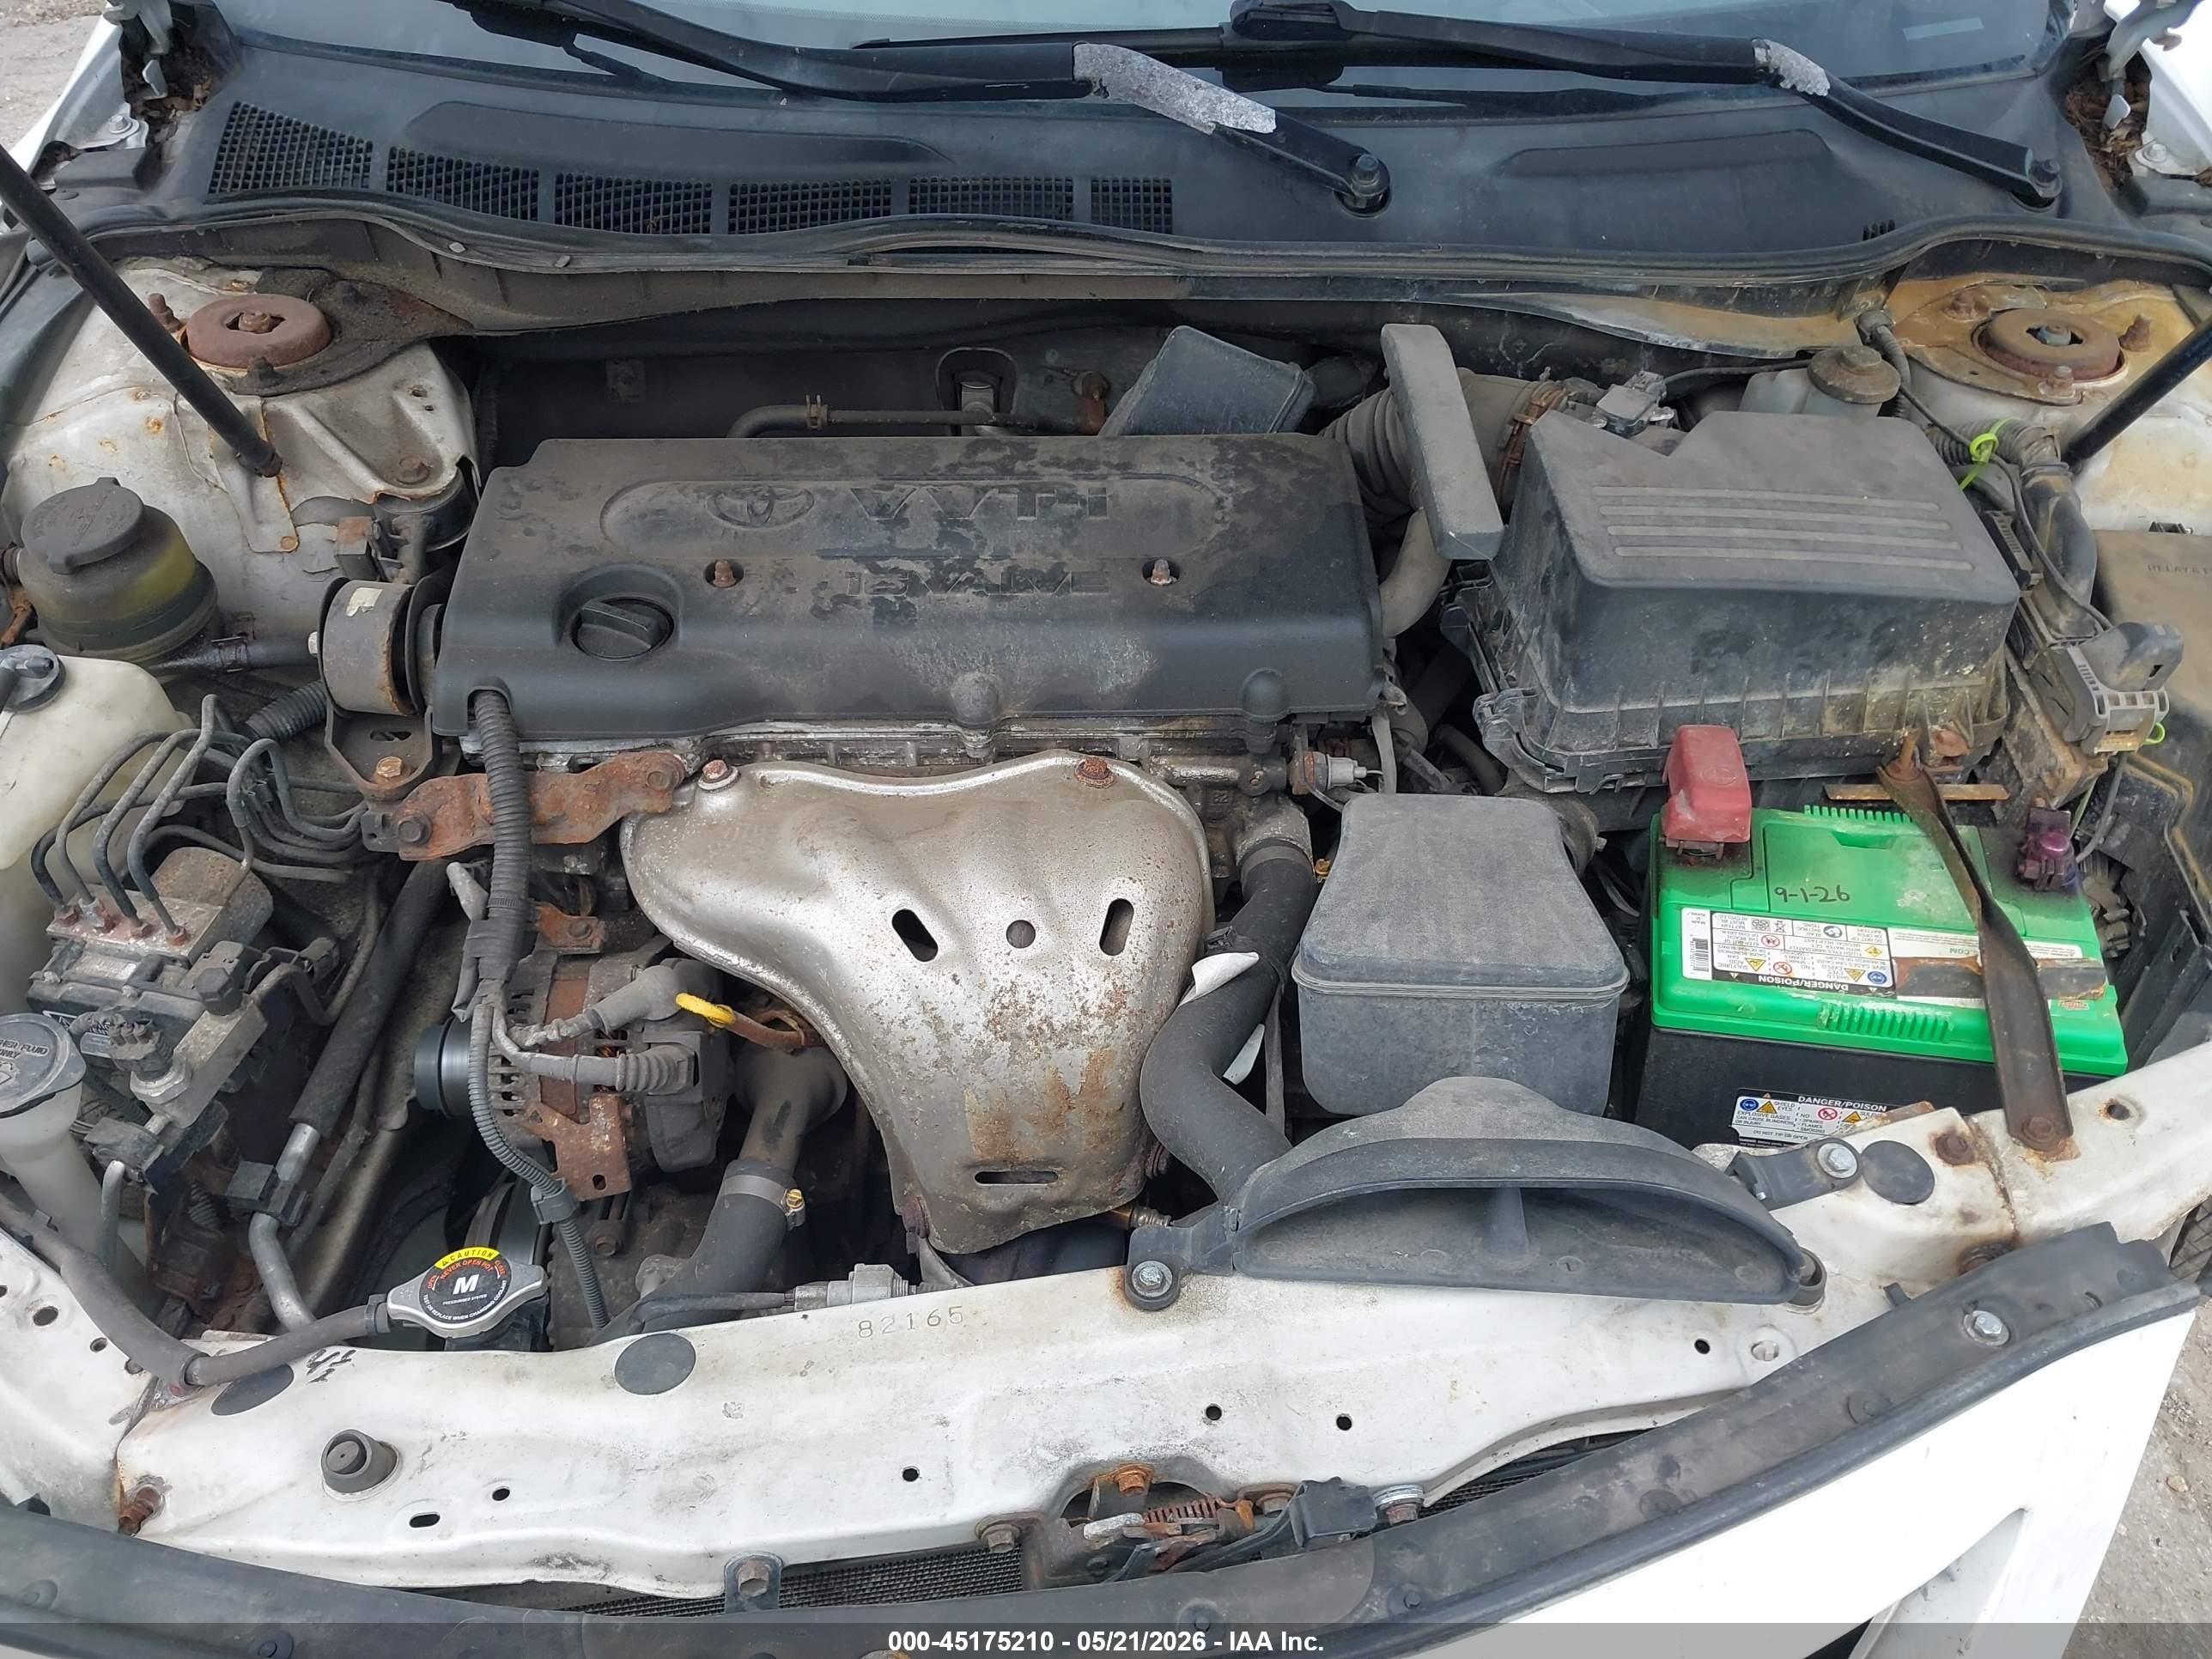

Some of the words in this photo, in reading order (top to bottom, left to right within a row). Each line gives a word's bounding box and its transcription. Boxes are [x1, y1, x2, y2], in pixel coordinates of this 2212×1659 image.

[1774, 884, 1850, 902] 9-1-26
[1759, 975, 1849, 991] DANGER/POISON
[1798, 1096, 1887, 1112] DANGER/POISON
[450, 1249, 493, 1261] CAUTION
[440, 1261, 462, 1279] NEVER
[453, 1274, 480, 1295] M
[432, 1309, 453, 1321] REPLACE
[859, 1305, 963, 1338] 82165
